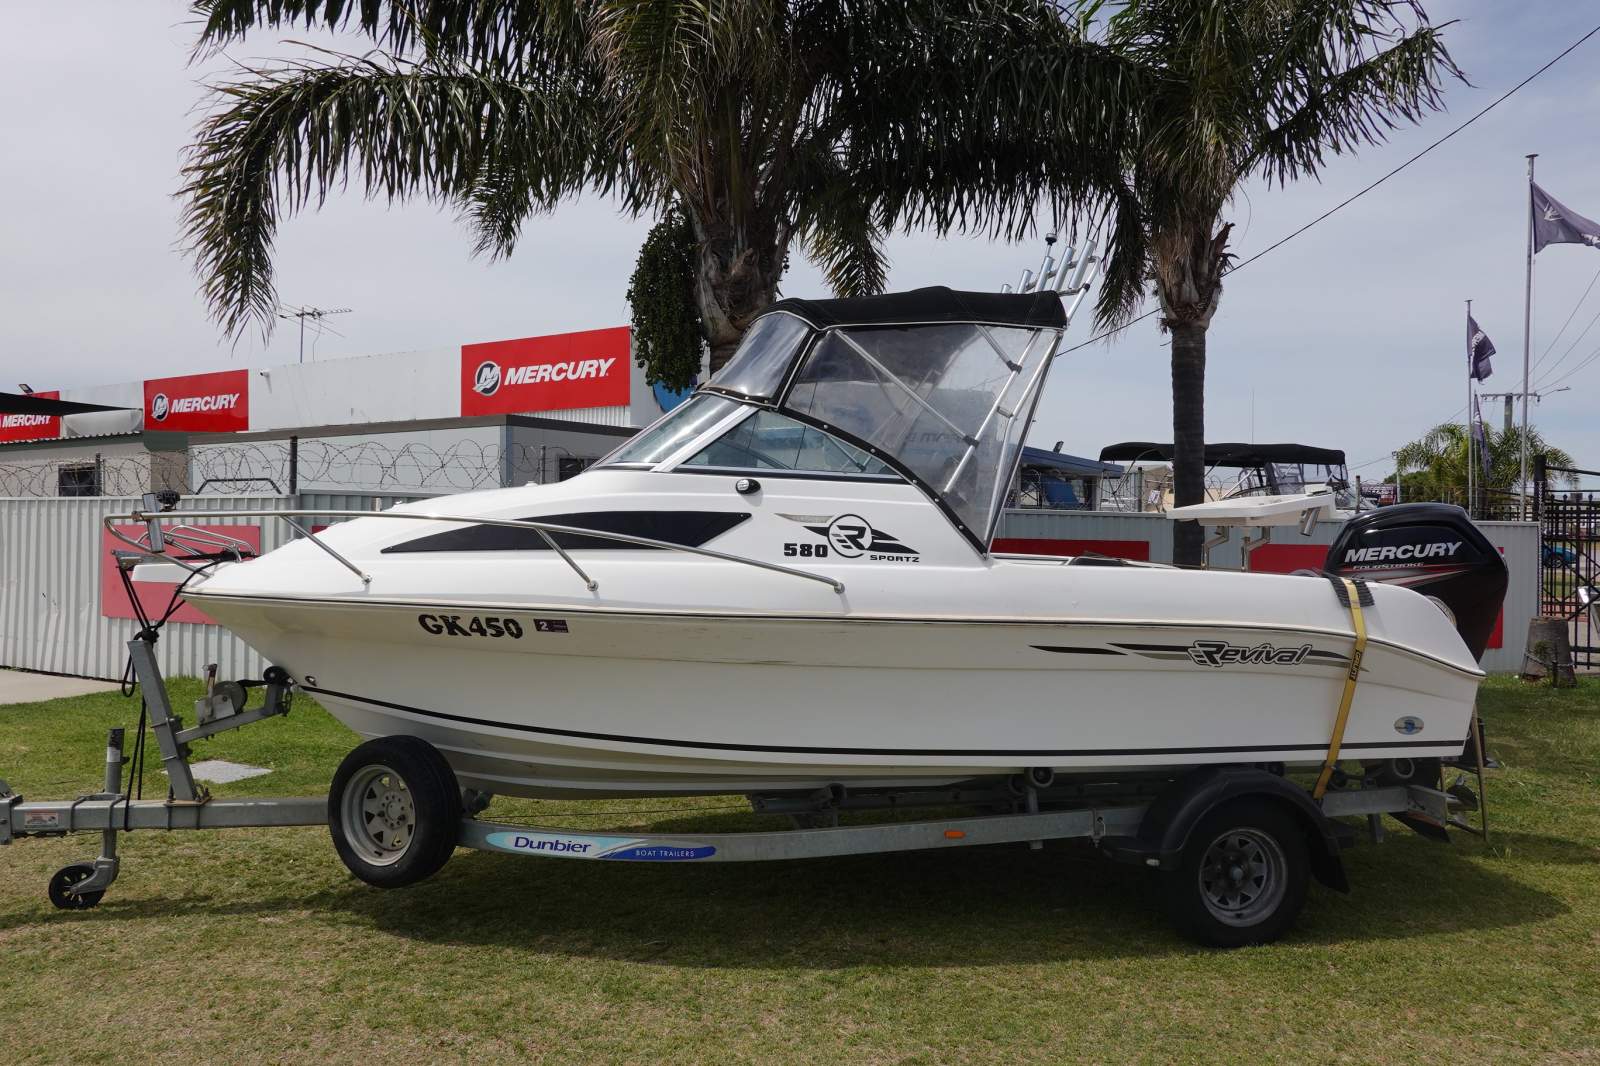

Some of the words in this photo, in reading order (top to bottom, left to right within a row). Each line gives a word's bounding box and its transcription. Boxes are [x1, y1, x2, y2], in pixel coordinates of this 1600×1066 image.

[504, 358, 616, 386] MERCURY
[171, 394, 240, 413] MERCURY
[2, 414, 51, 428] MERCURY
[784, 543, 828, 558] 580
[870, 554, 920, 562] SPORTZ
[1344, 542, 1462, 562] MERCURY
[418, 614, 523, 638] GK450
[1187, 640, 1313, 667] Revival
[514, 837, 591, 852] Dunbier
